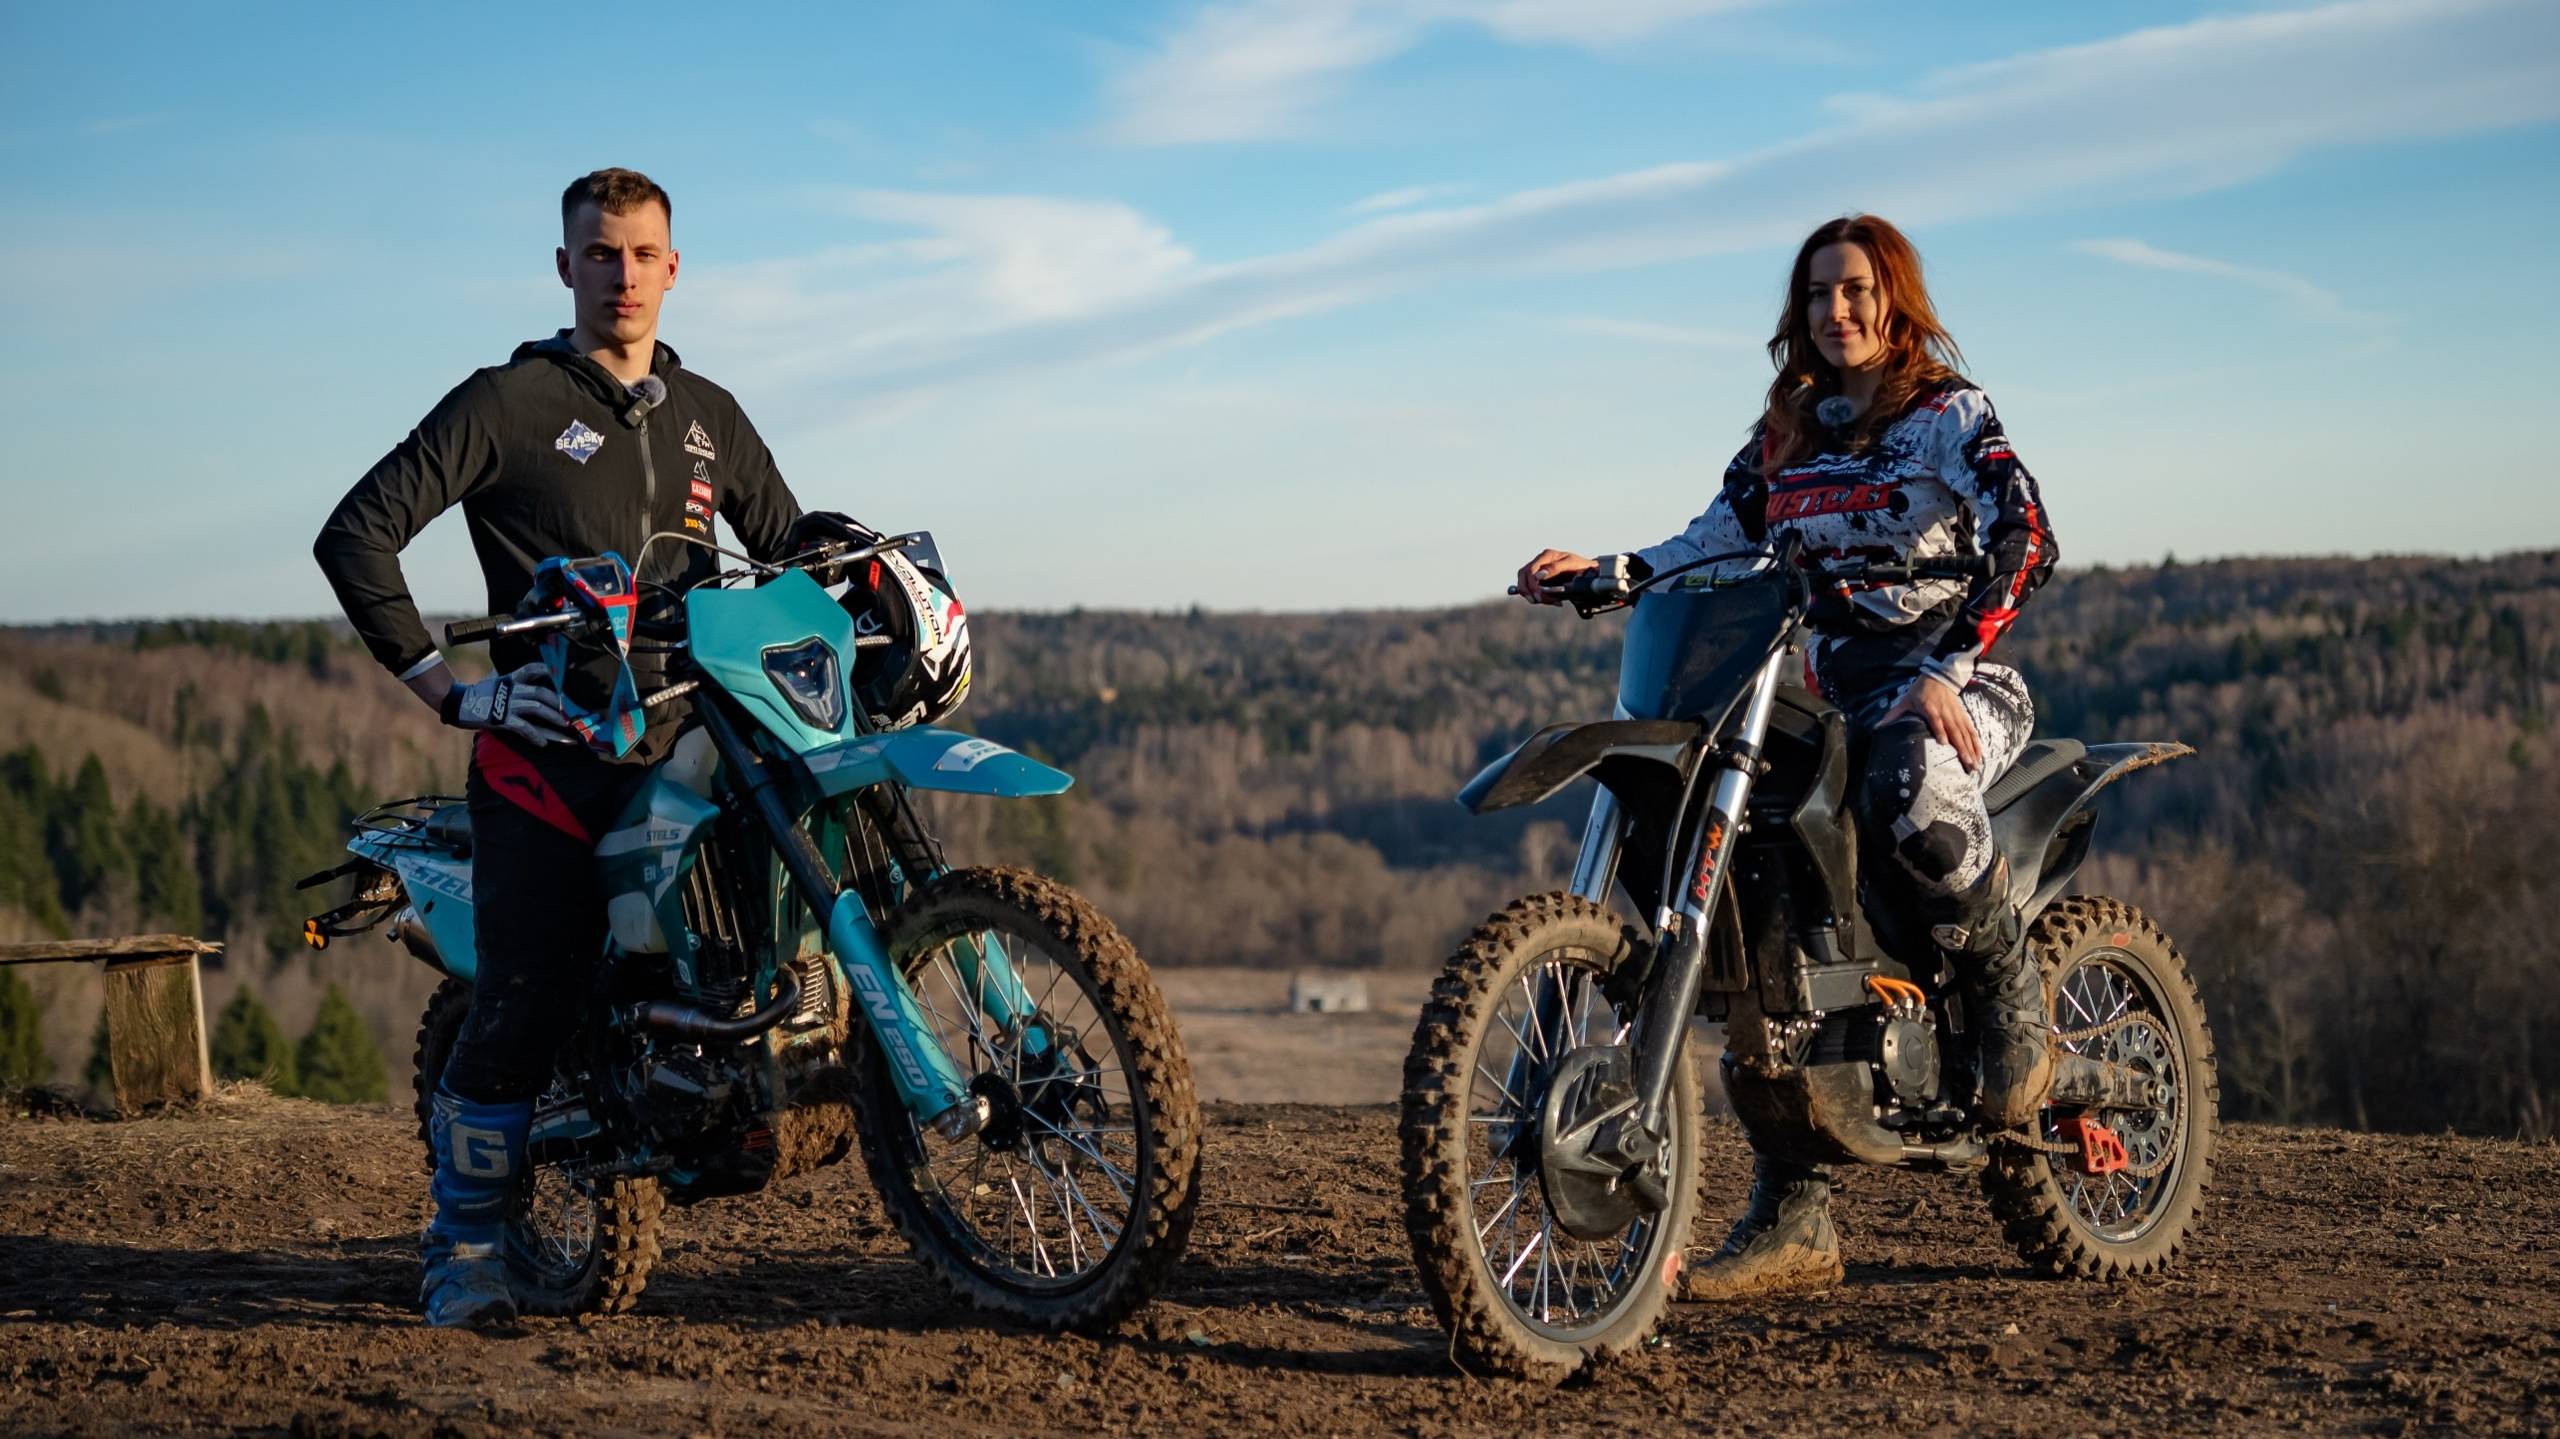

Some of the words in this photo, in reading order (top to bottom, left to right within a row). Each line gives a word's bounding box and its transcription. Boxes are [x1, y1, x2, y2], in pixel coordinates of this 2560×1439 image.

[645, 827, 681, 842] STELS
[407, 865, 472, 900] STEL
[846, 963, 899, 1020] EN
[883, 1027, 930, 1087] 250
